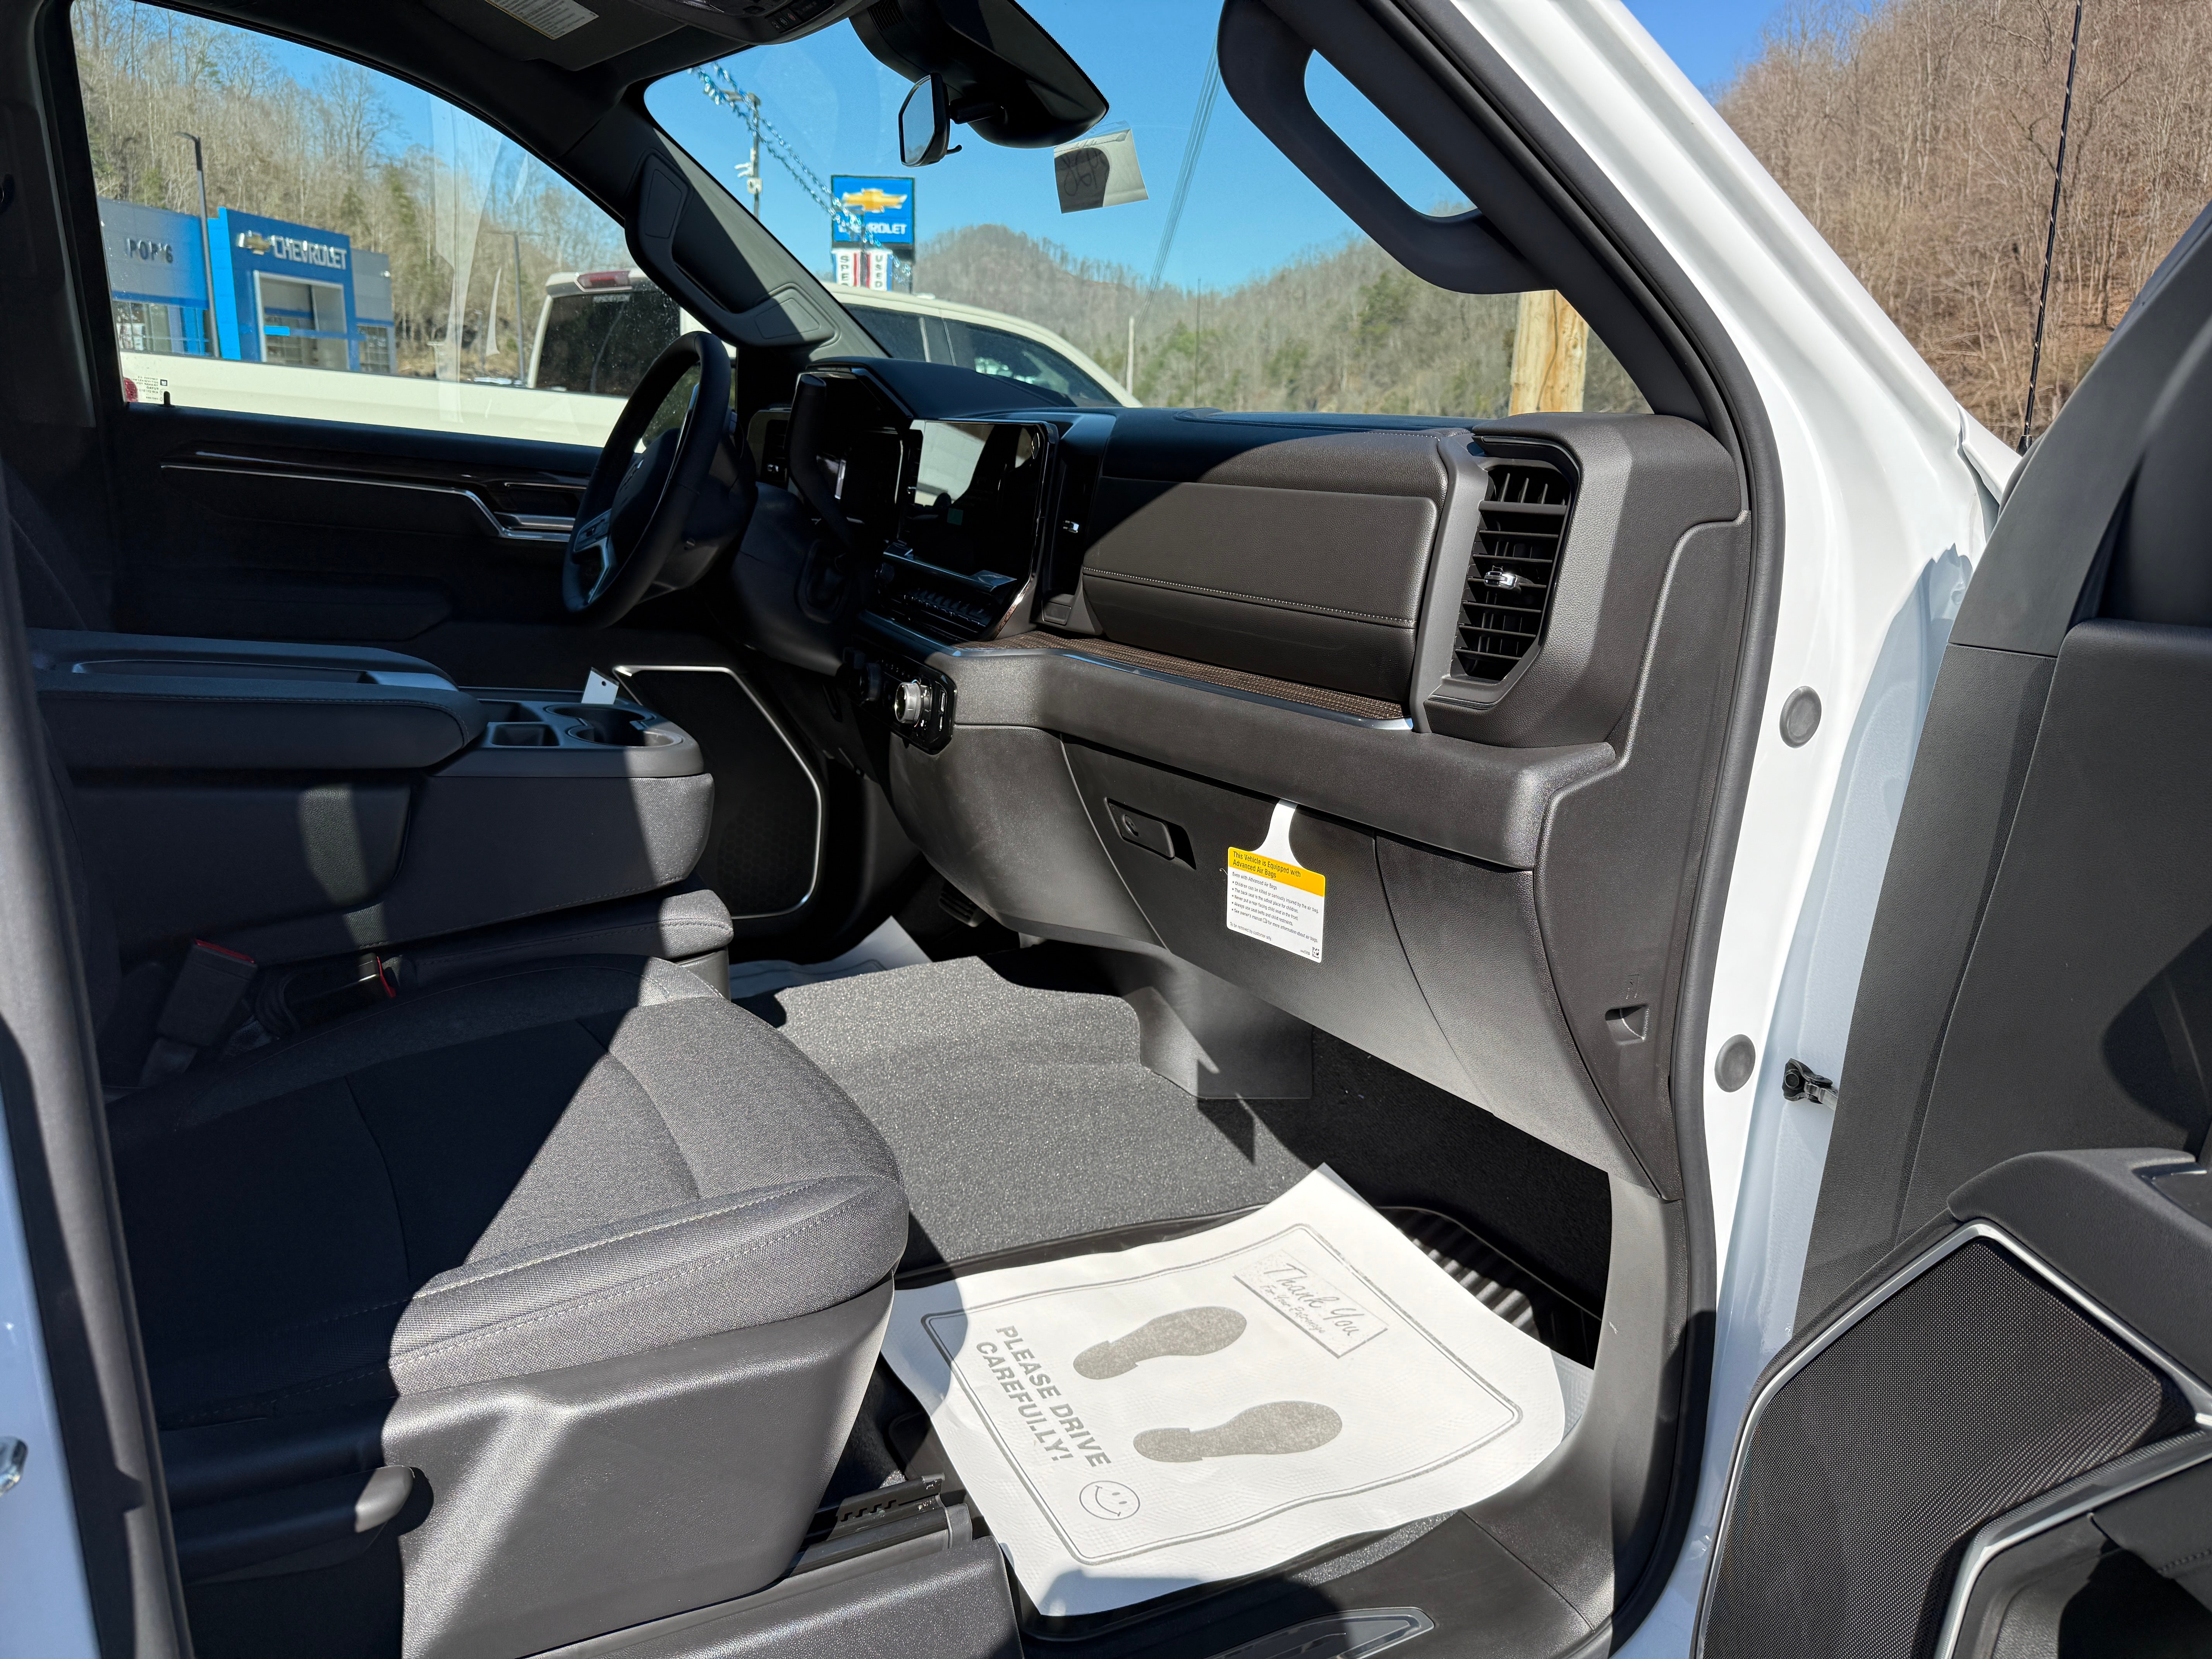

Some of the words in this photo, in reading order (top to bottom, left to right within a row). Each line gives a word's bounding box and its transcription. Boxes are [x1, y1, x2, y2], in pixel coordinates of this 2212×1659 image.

[271, 235, 347, 270] CHEVROLET
[875, 254, 883, 288] USED
[1233, 851, 1243, 859] This
[1244, 854, 1261, 865] Vehicle
[1267, 861, 1289, 874] Equipped
[1290, 869, 1301, 878] with
[1233, 859, 1255, 871] Advanced
[1265, 869, 1276, 878] Bags
[1248, 877, 1263, 885] Advanced
[1263, 1263, 1340, 1309] Thank
[1323, 1308, 1365, 1336] You
[1273, 1294, 1291, 1308] Your
[976, 1341, 1074, 1462] CAREFULLY!
[996, 1325, 1062, 1400] PLEASE
[1049, 1403, 1112, 1468] DRIVE
